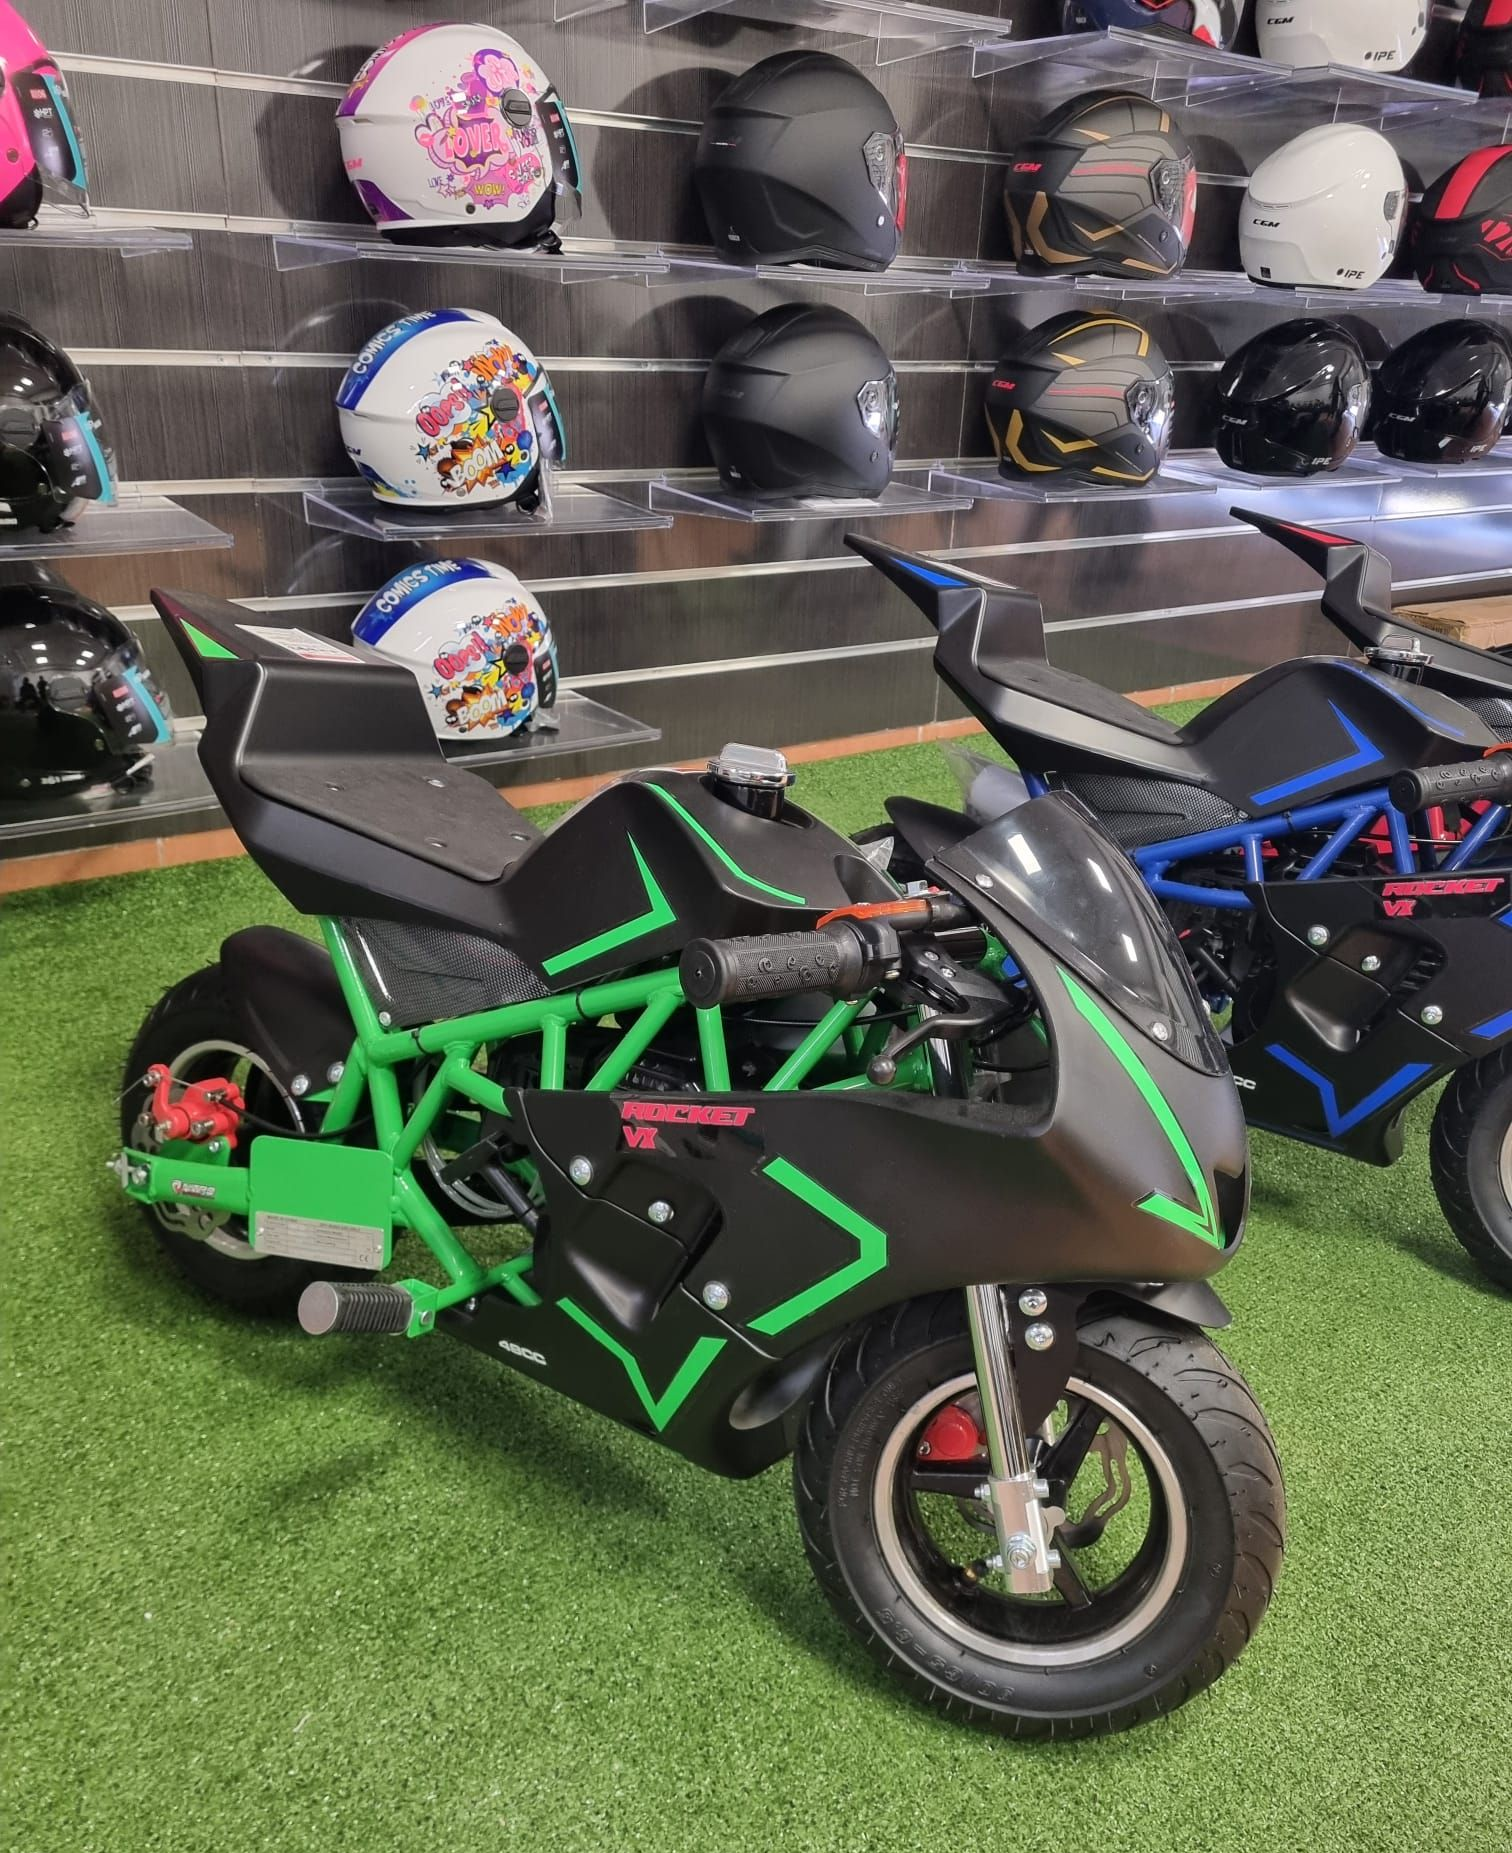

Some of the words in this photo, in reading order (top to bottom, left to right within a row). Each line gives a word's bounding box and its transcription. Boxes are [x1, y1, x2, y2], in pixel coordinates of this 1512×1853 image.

[1266, 16, 1295, 25] CGM
[1373, 50, 1396, 61] IPE
[1012, 162, 1043, 173] CGM
[1253, 218, 1280, 228] CGM
[1344, 268, 1365, 280] IPE
[352, 322, 401, 375] COMICS
[399, 309, 437, 328] TIME
[991, 379, 1016, 390] CGM
[1221, 414, 1248, 425] CGM
[1387, 412, 1417, 423] CGM
[446, 440, 504, 488] BOOM
[1311, 456, 1332, 466] IPE
[375, 569, 429, 614] COMICS
[424, 559, 462, 577] TIME
[456, 689, 508, 726] BOOM
[1382, 878, 1505, 897] ROCKET
[621, 1101, 756, 1127] ROCKET
[622, 1125, 658, 1149] VX
